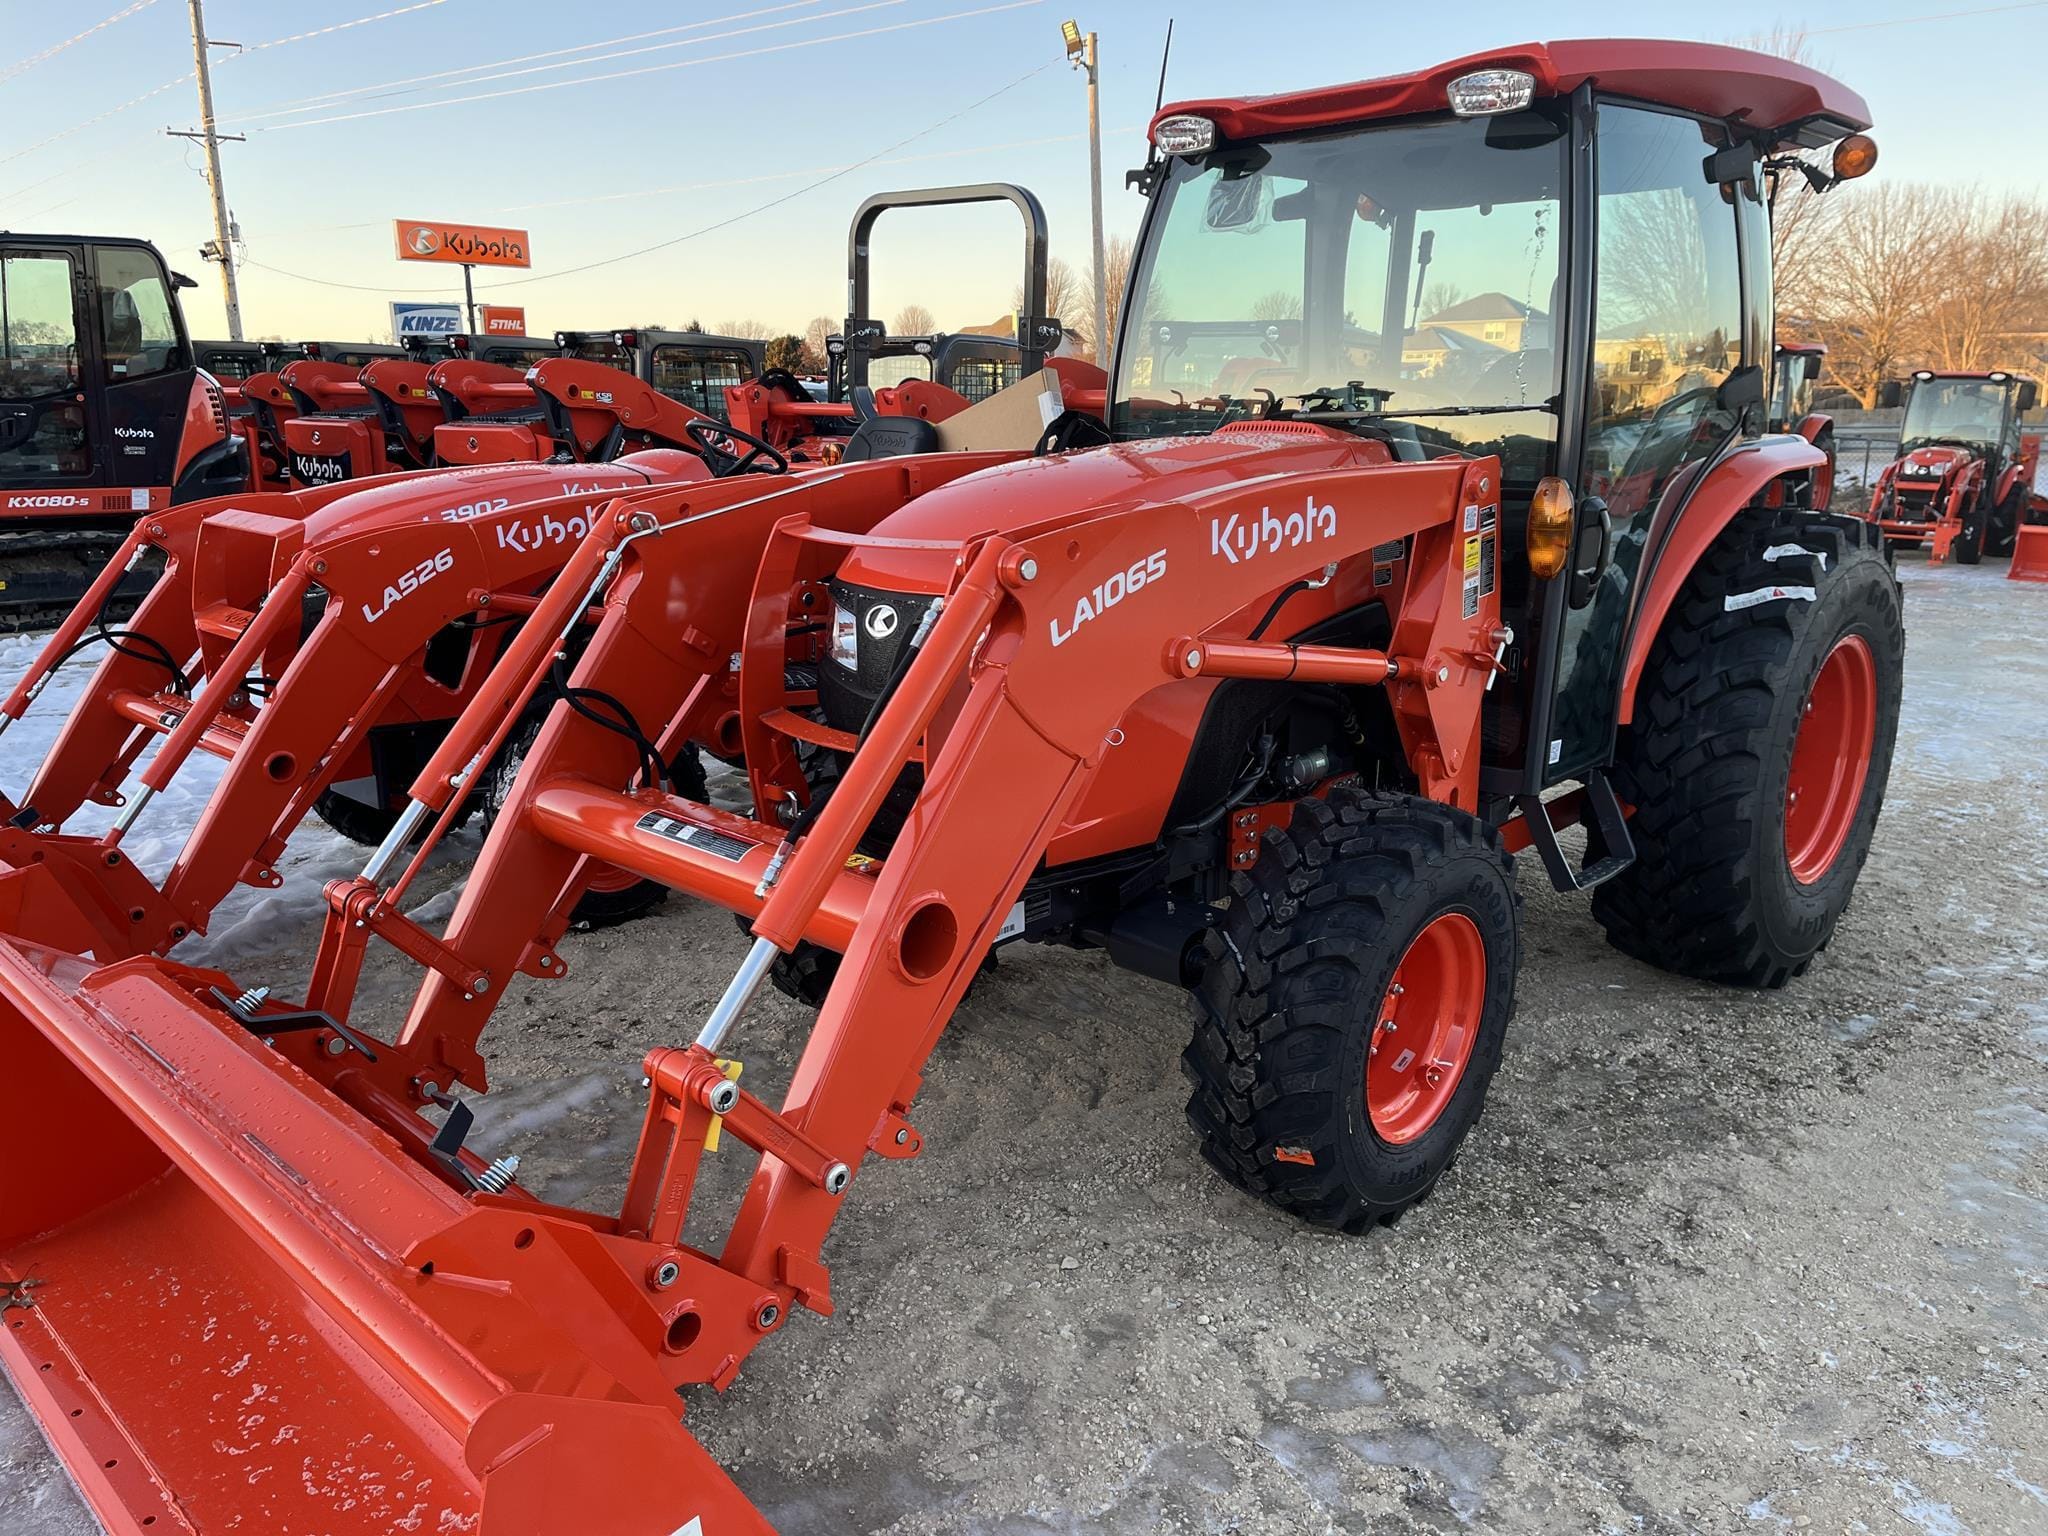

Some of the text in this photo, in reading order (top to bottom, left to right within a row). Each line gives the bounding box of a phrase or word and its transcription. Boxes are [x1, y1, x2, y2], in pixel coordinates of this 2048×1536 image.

[443, 231, 523, 259] Kubota
[401, 316, 459, 332] KINZE
[489, 319, 523, 331] STIHL
[114, 427, 155, 438] Kubota
[296, 455, 343, 479] Kubota
[1211, 495, 1337, 564] Kubota
[362, 548, 454, 623] LA526
[1050, 548, 1167, 648] LA1065
